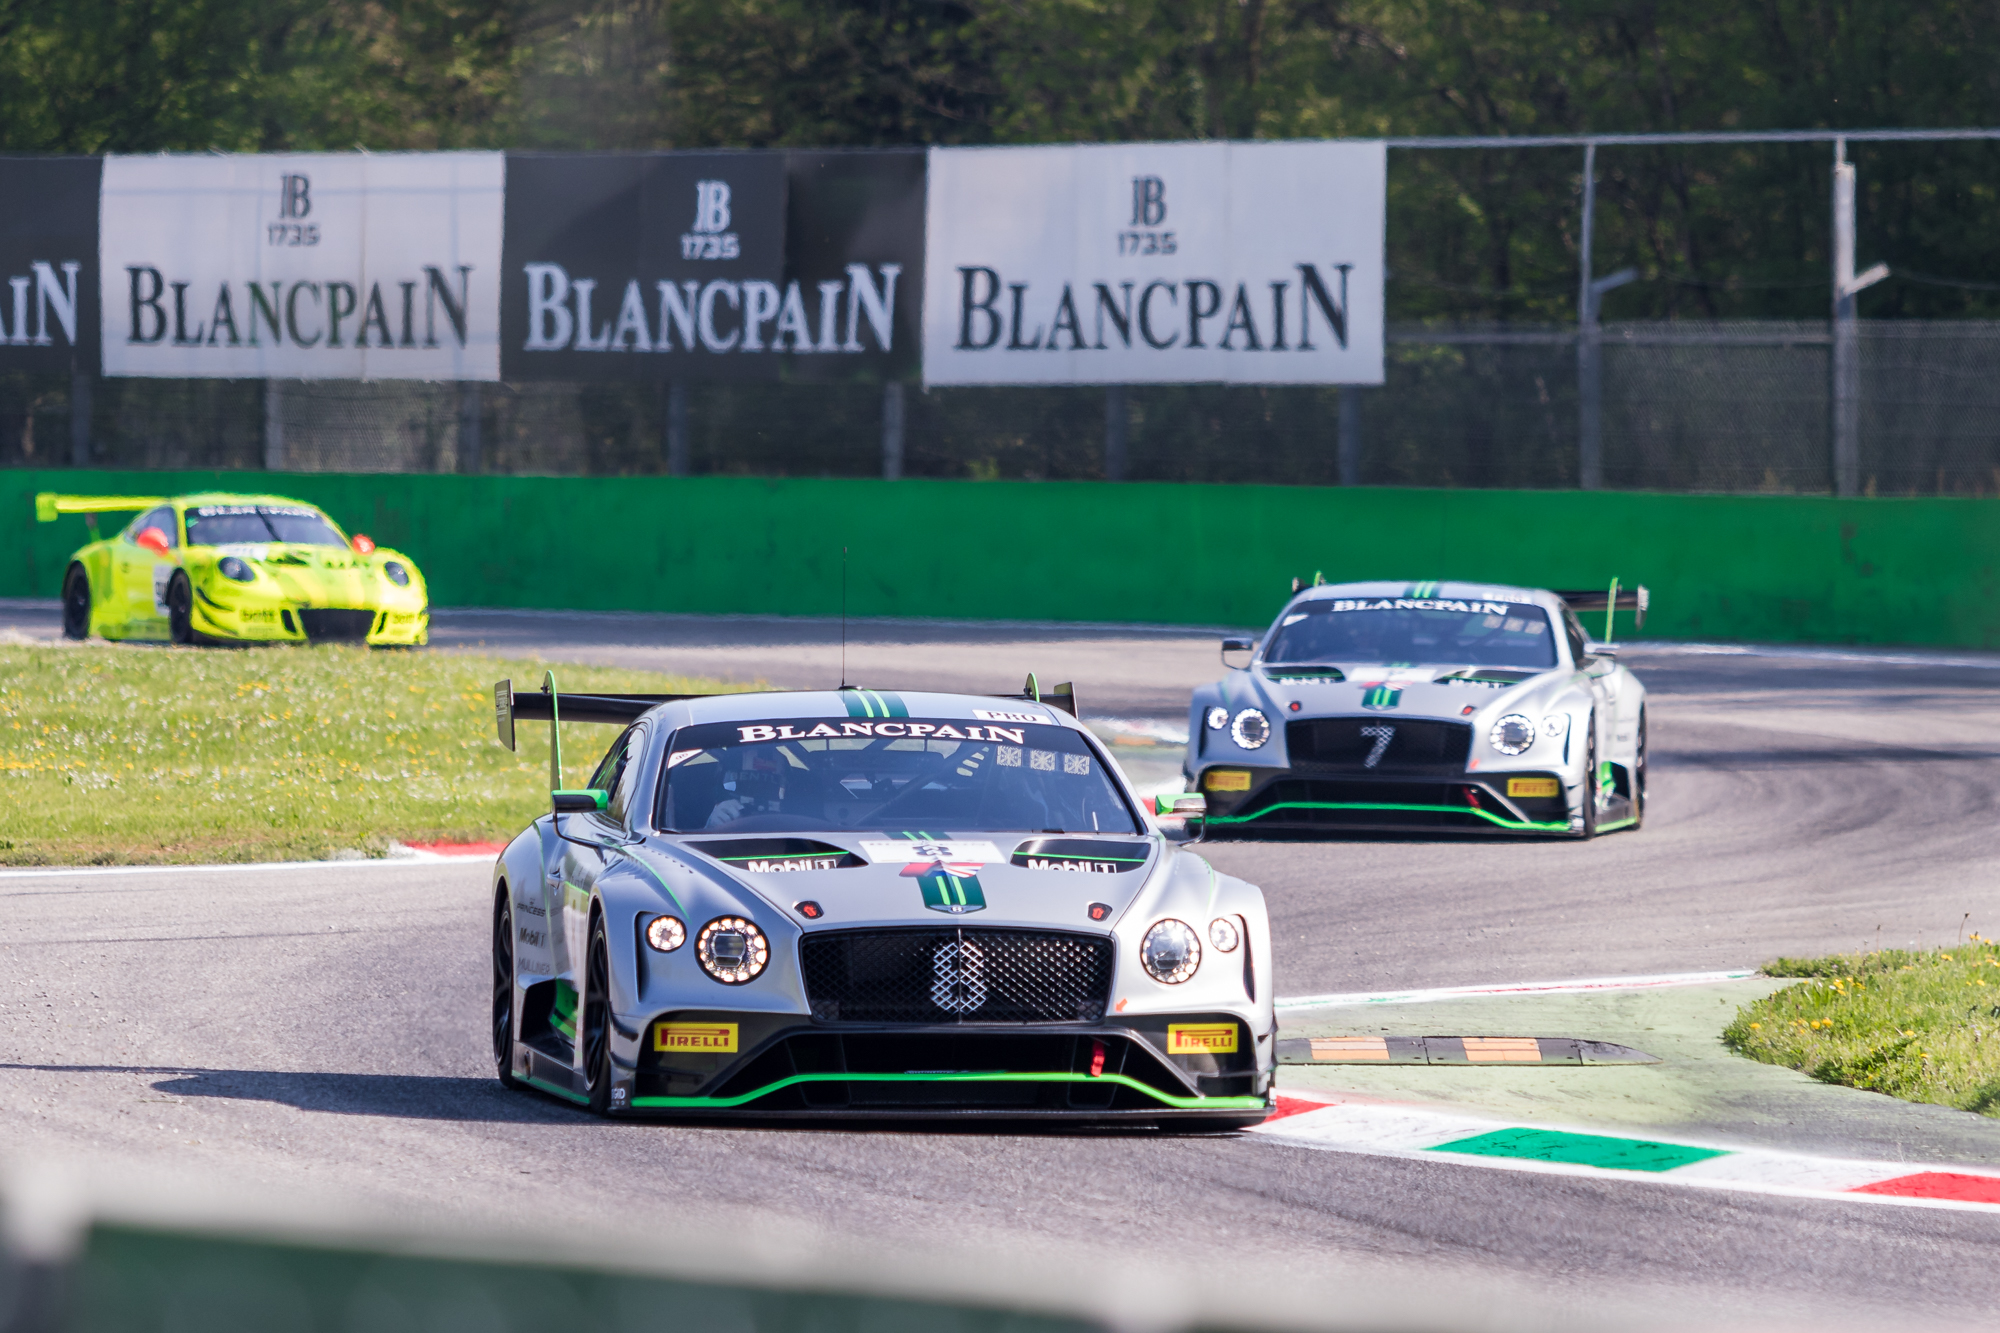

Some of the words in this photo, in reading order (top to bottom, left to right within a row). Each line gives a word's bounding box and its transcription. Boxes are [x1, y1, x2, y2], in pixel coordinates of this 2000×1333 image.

[267, 224, 321, 247] 1735
[681, 234, 740, 260] 1735
[1118, 232, 1177, 256] 1735
[0, 260, 81, 346] IN
[124, 263, 474, 349] BLANCPAIN
[523, 262, 902, 353] BLANCPAIN
[953, 263, 1354, 351] BLANCPAIN
[1332, 599, 1510, 616] BLANCPAIN
[987, 711, 1037, 722] PRO
[736, 722, 1025, 745] BLANCPAIN
[1361, 725, 1397, 769] 7
[748, 860, 812, 872] Mobil
[1028, 859, 1092, 872] Mobil
[931, 941, 987, 1014] 8
[660, 1028, 730, 1047] PIRELLI
[1175, 1029, 1233, 1048] PIRELLI
